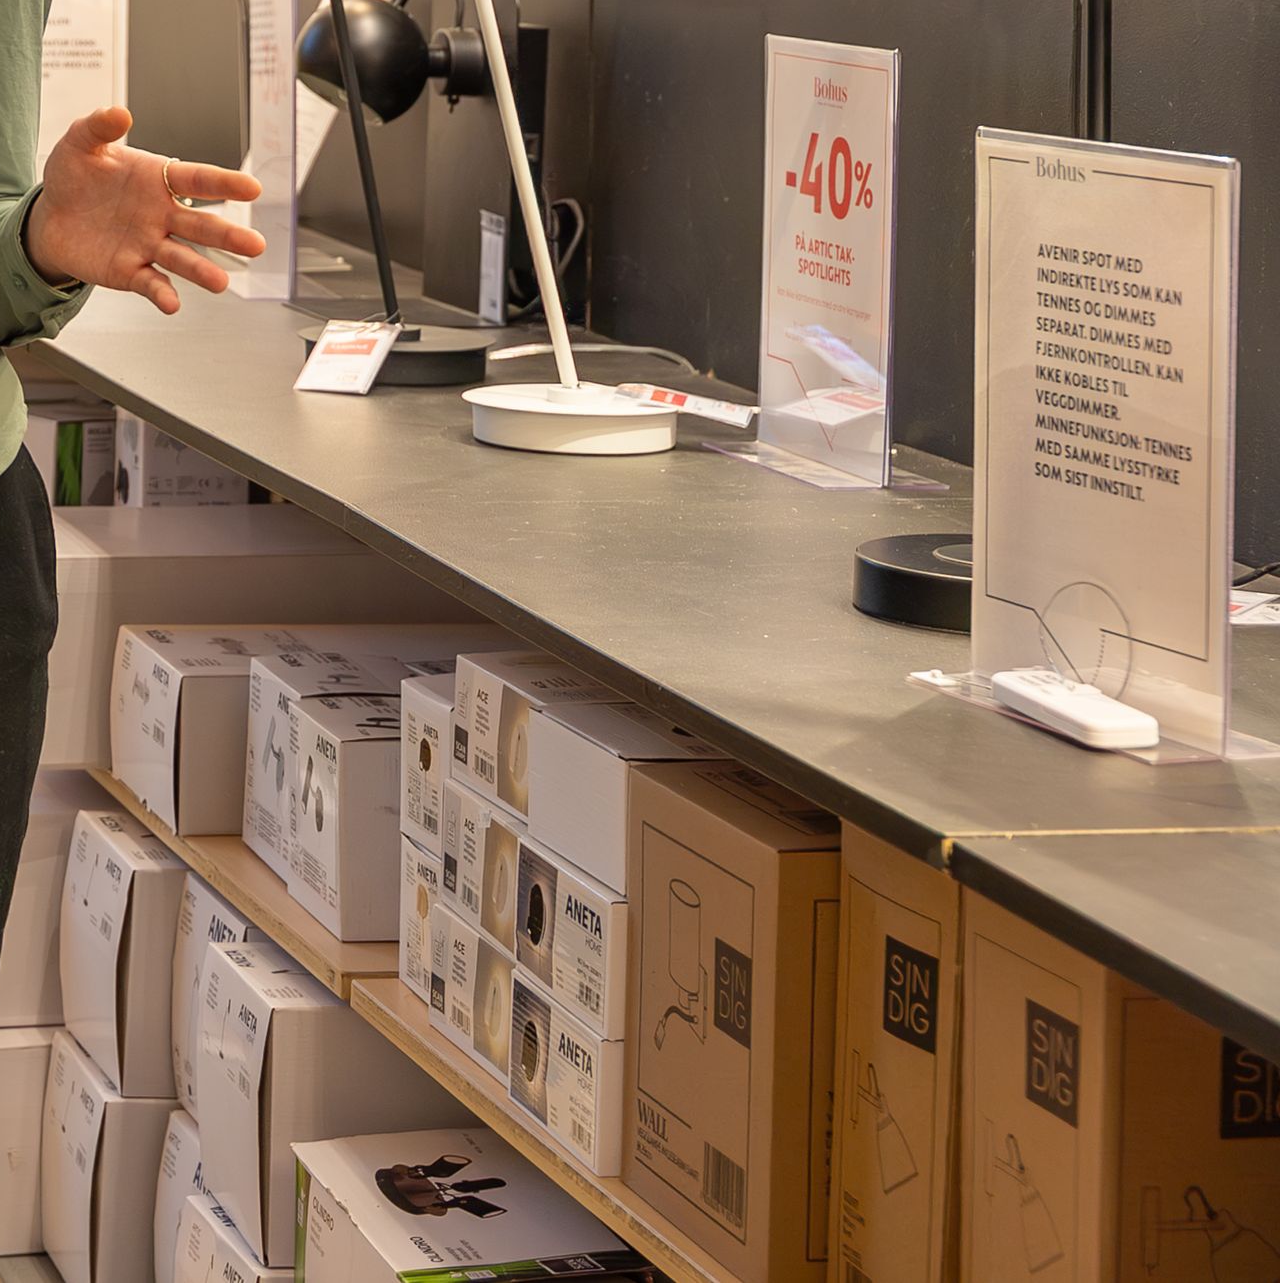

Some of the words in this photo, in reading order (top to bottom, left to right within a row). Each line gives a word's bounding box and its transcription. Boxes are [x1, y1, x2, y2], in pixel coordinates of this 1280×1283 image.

[813, 76, 848, 104] Bohus
[1035, 155, 1086, 183] Bohus
[794, 230, 806, 253] PÅ
[808, 239, 834, 261] ARTIC
[835, 243, 856, 265] TAK-
[1037, 243, 1080, 264] AVENIR
[1081, 250, 1112, 269] SPOT
[1114, 255, 1143, 274] MED
[797, 257, 851, 287] SPOTLIGHTS
[1036, 267, 1097, 292] INDIREKTE
[1099, 278, 1120, 295] LYS
[1122, 282, 1153, 300] SOM
[1154, 286, 1183, 306] KAN
[1036, 291, 1081, 314] TENNES
[1083, 300, 1102, 317] OG
[1104, 304, 1156, 327] DIMMES
[1036, 316, 1087, 340] SEPARAT.
[1090, 326, 1141, 350] DIMMES
[1143, 336, 1173, 356] MED
[1035, 340, 1154, 378] FJERNKONTROLLEN.
[1156, 364, 1184, 384] KAN
[1035, 364, 1062, 384] IKKE
[1064, 370, 1109, 393] KOBLES
[1111, 380, 1129, 398] TIL
[1035, 388, 1122, 421] VEGGDIMMER.
[1035, 413, 1142, 450] MINNEFUNKSJON:
[1144, 437, 1193, 462] TENNES
[1035, 437, 1062, 457] MED
[1064, 444, 1110, 469] SAMME
[1113, 455, 1180, 485] LYSSTYRKE
[1034, 461, 1063, 482] SOM
[1065, 468, 1088, 488] SIST
[1090, 475, 1145, 502] INNSTILT.
[315, 733, 337, 765] ANETA
[416, 862, 438, 887] ANETA
[565, 893, 603, 940] ANETA
[585, 935, 602, 958] HOME
[719, 955, 747, 998] SIN
[889, 953, 931, 1001] SIN
[238, 1003, 258, 1035] ANETA
[718, 988, 747, 1030] DIG
[887, 988, 930, 1035] DIG
[558, 1032, 593, 1078] ANETA
[1031, 1018, 1074, 1068] SIN
[1030, 1056, 1073, 1108] DIG
[637, 1098, 669, 1143] WALL
[1234, 1088, 1280, 1123] DI
[311, 1195, 335, 1232] CILINDRO
